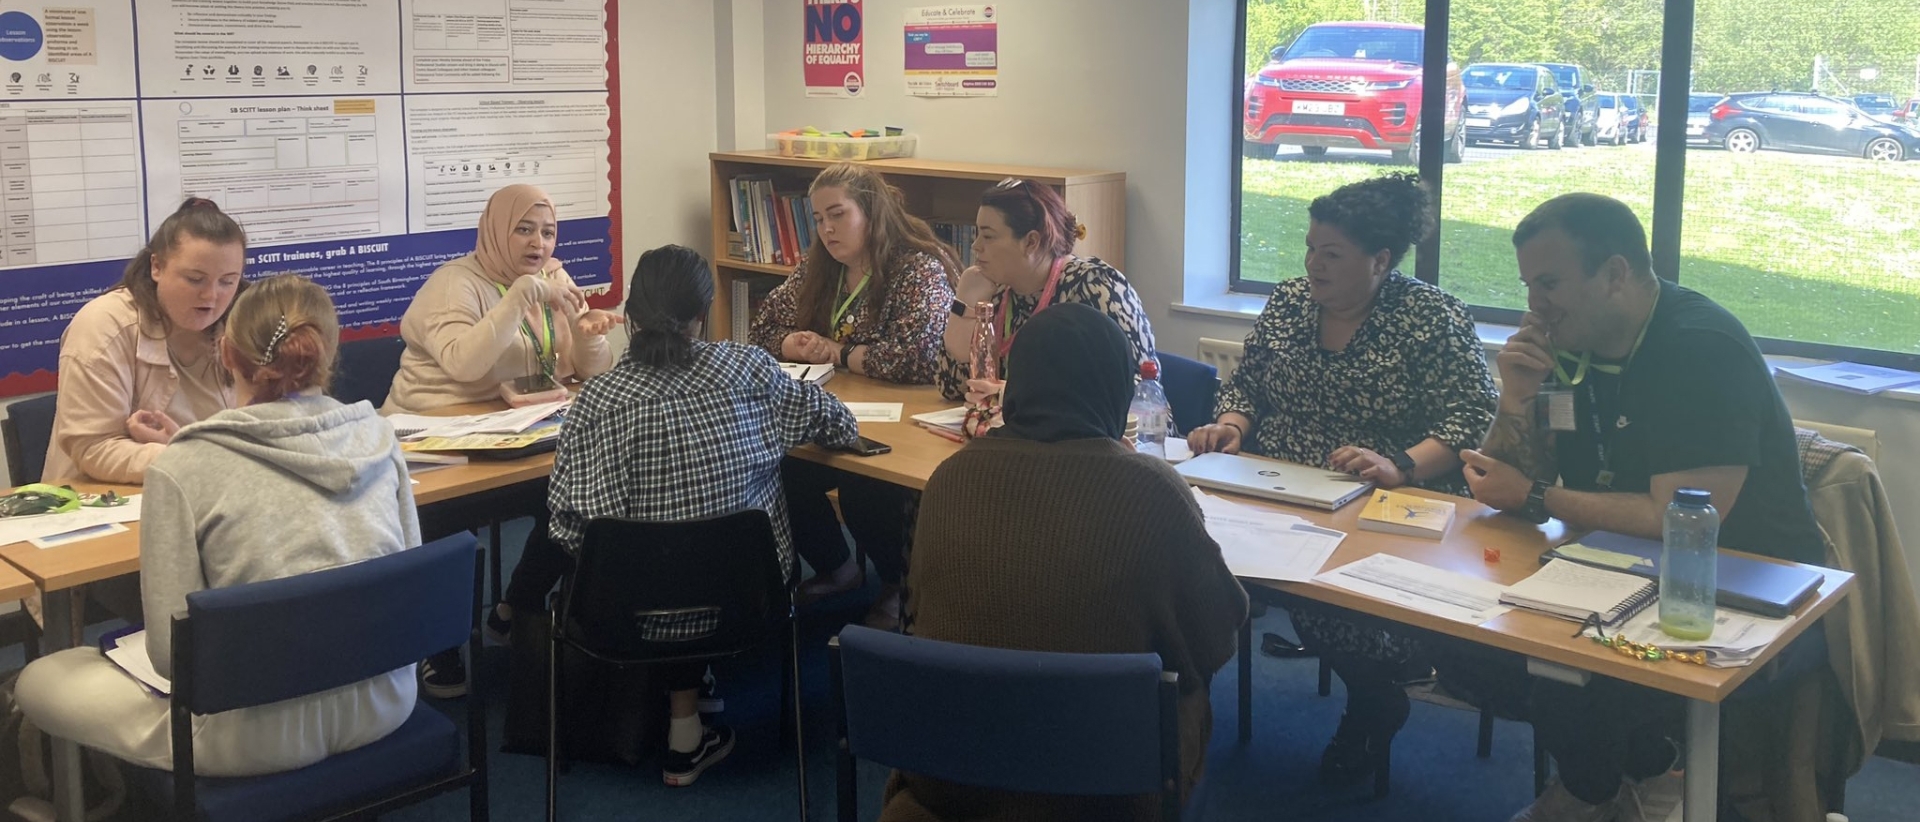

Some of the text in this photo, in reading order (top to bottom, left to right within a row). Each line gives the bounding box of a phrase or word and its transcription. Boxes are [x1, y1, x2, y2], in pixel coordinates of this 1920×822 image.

[921, 9, 941, 17] Educate
[807, 4, 861, 43] NO
[806, 43, 860, 54] HIERARCHY
[806, 55, 860, 64] OF EQUALITY
[258, 253, 281, 264] SCITT
[283, 250, 323, 261] trainees,
[326, 247, 346, 259] grab
[349, 246, 356, 255] A
[358, 243, 389, 254] BISCUIT
[347, 281, 370, 289] principles
[20, 341, 31, 349] get
